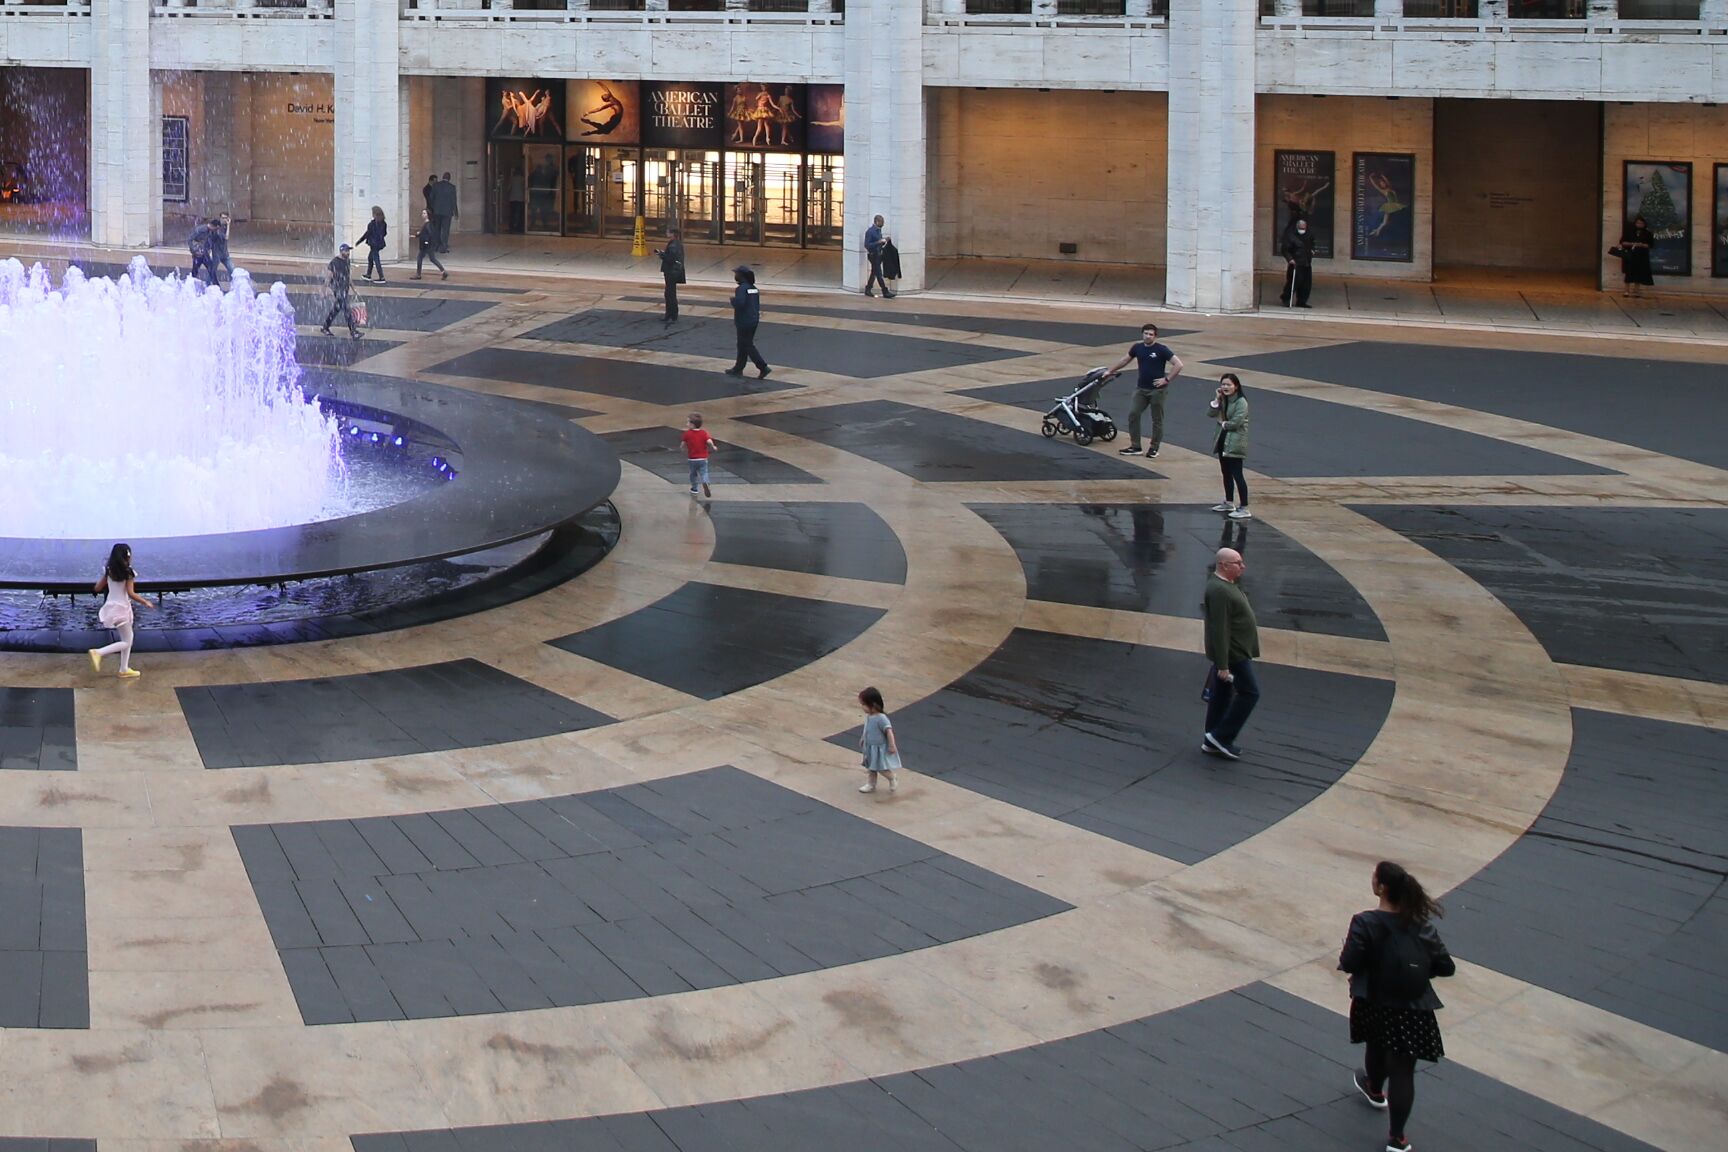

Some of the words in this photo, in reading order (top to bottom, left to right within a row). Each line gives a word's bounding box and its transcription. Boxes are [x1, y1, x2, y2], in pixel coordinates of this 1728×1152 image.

[648, 90, 718, 103] AMERICAN
[287, 103, 313, 113] David
[316, 104, 326, 113] H.
[654, 100, 712, 116] BALLET
[652, 115, 714, 129] THEATRE
